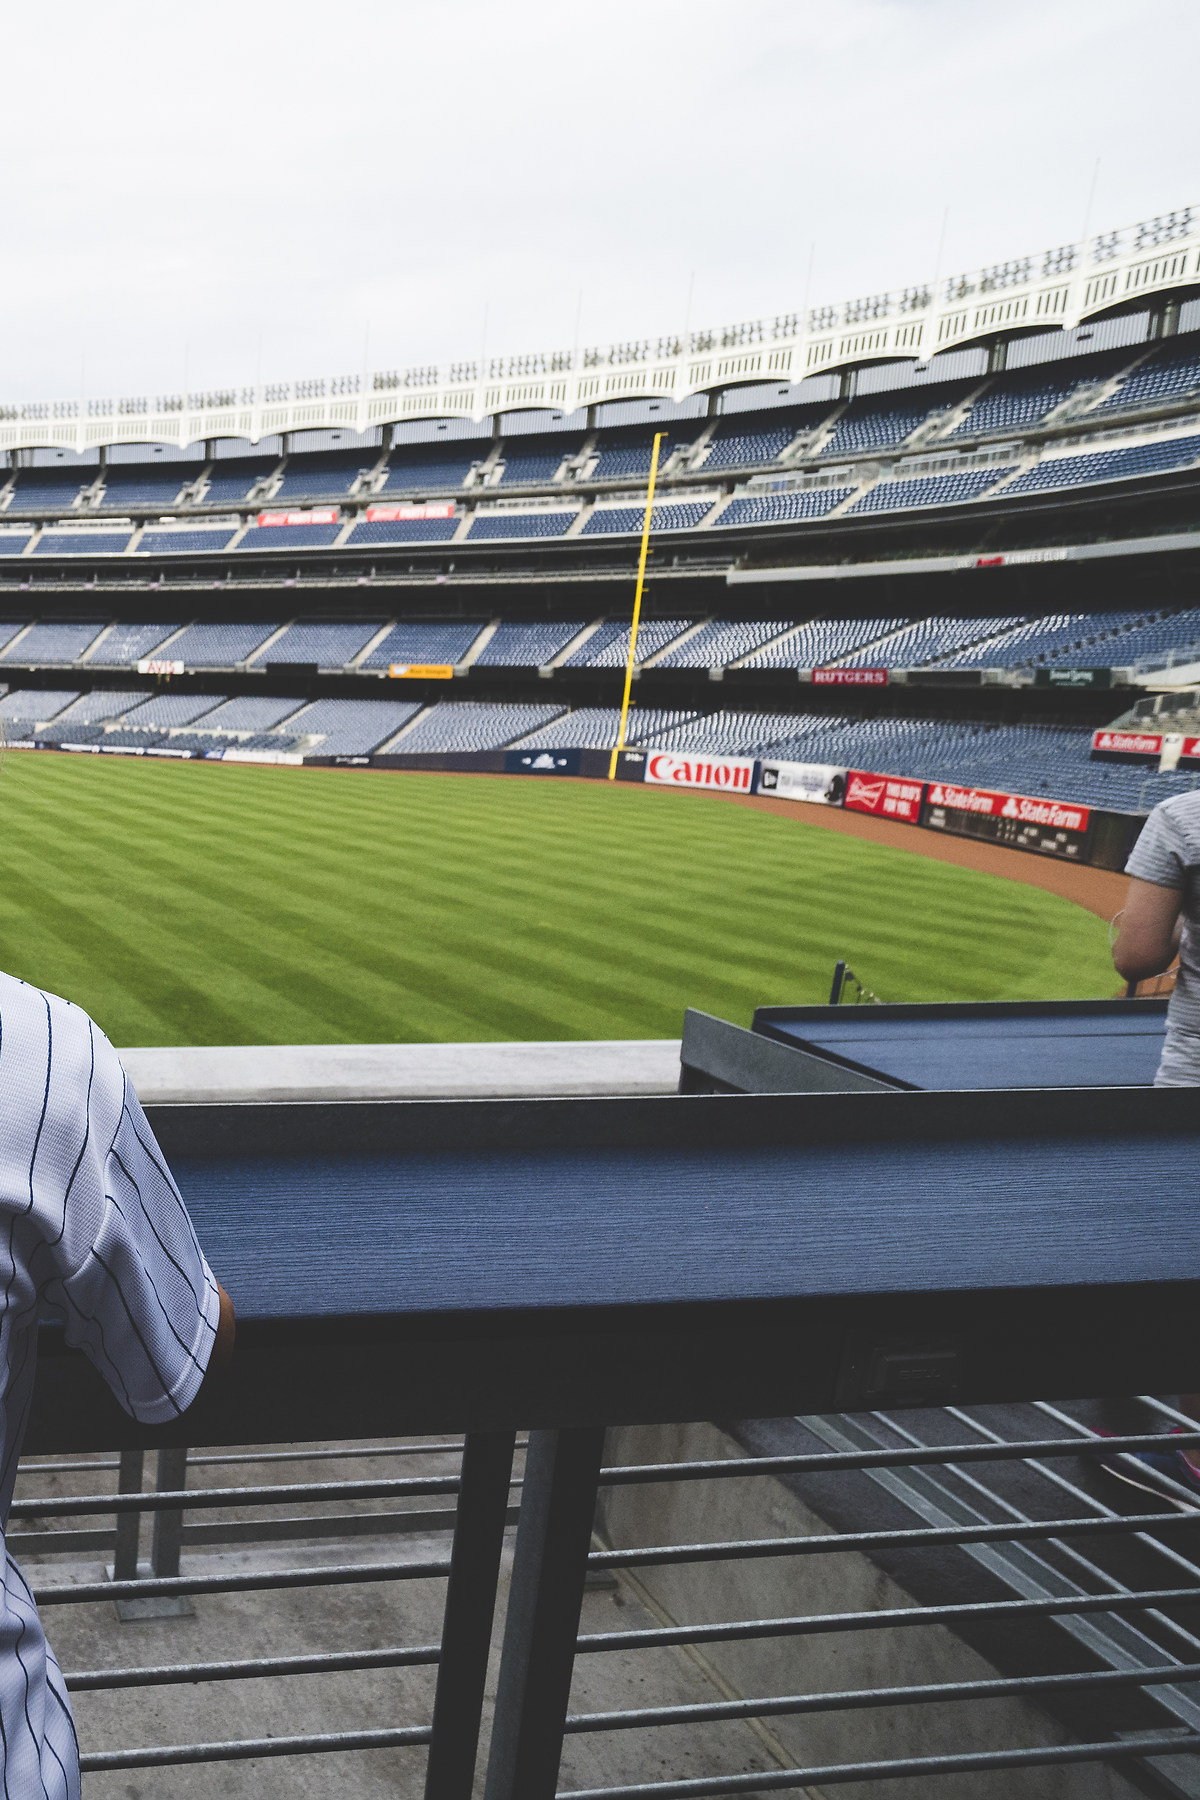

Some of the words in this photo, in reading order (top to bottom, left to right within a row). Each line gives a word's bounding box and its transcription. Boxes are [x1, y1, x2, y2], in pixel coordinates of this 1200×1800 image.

[147, 661, 175, 674] AVIS
[815, 671, 883, 683] RUTGERS
[649, 754, 750, 789] Canon
